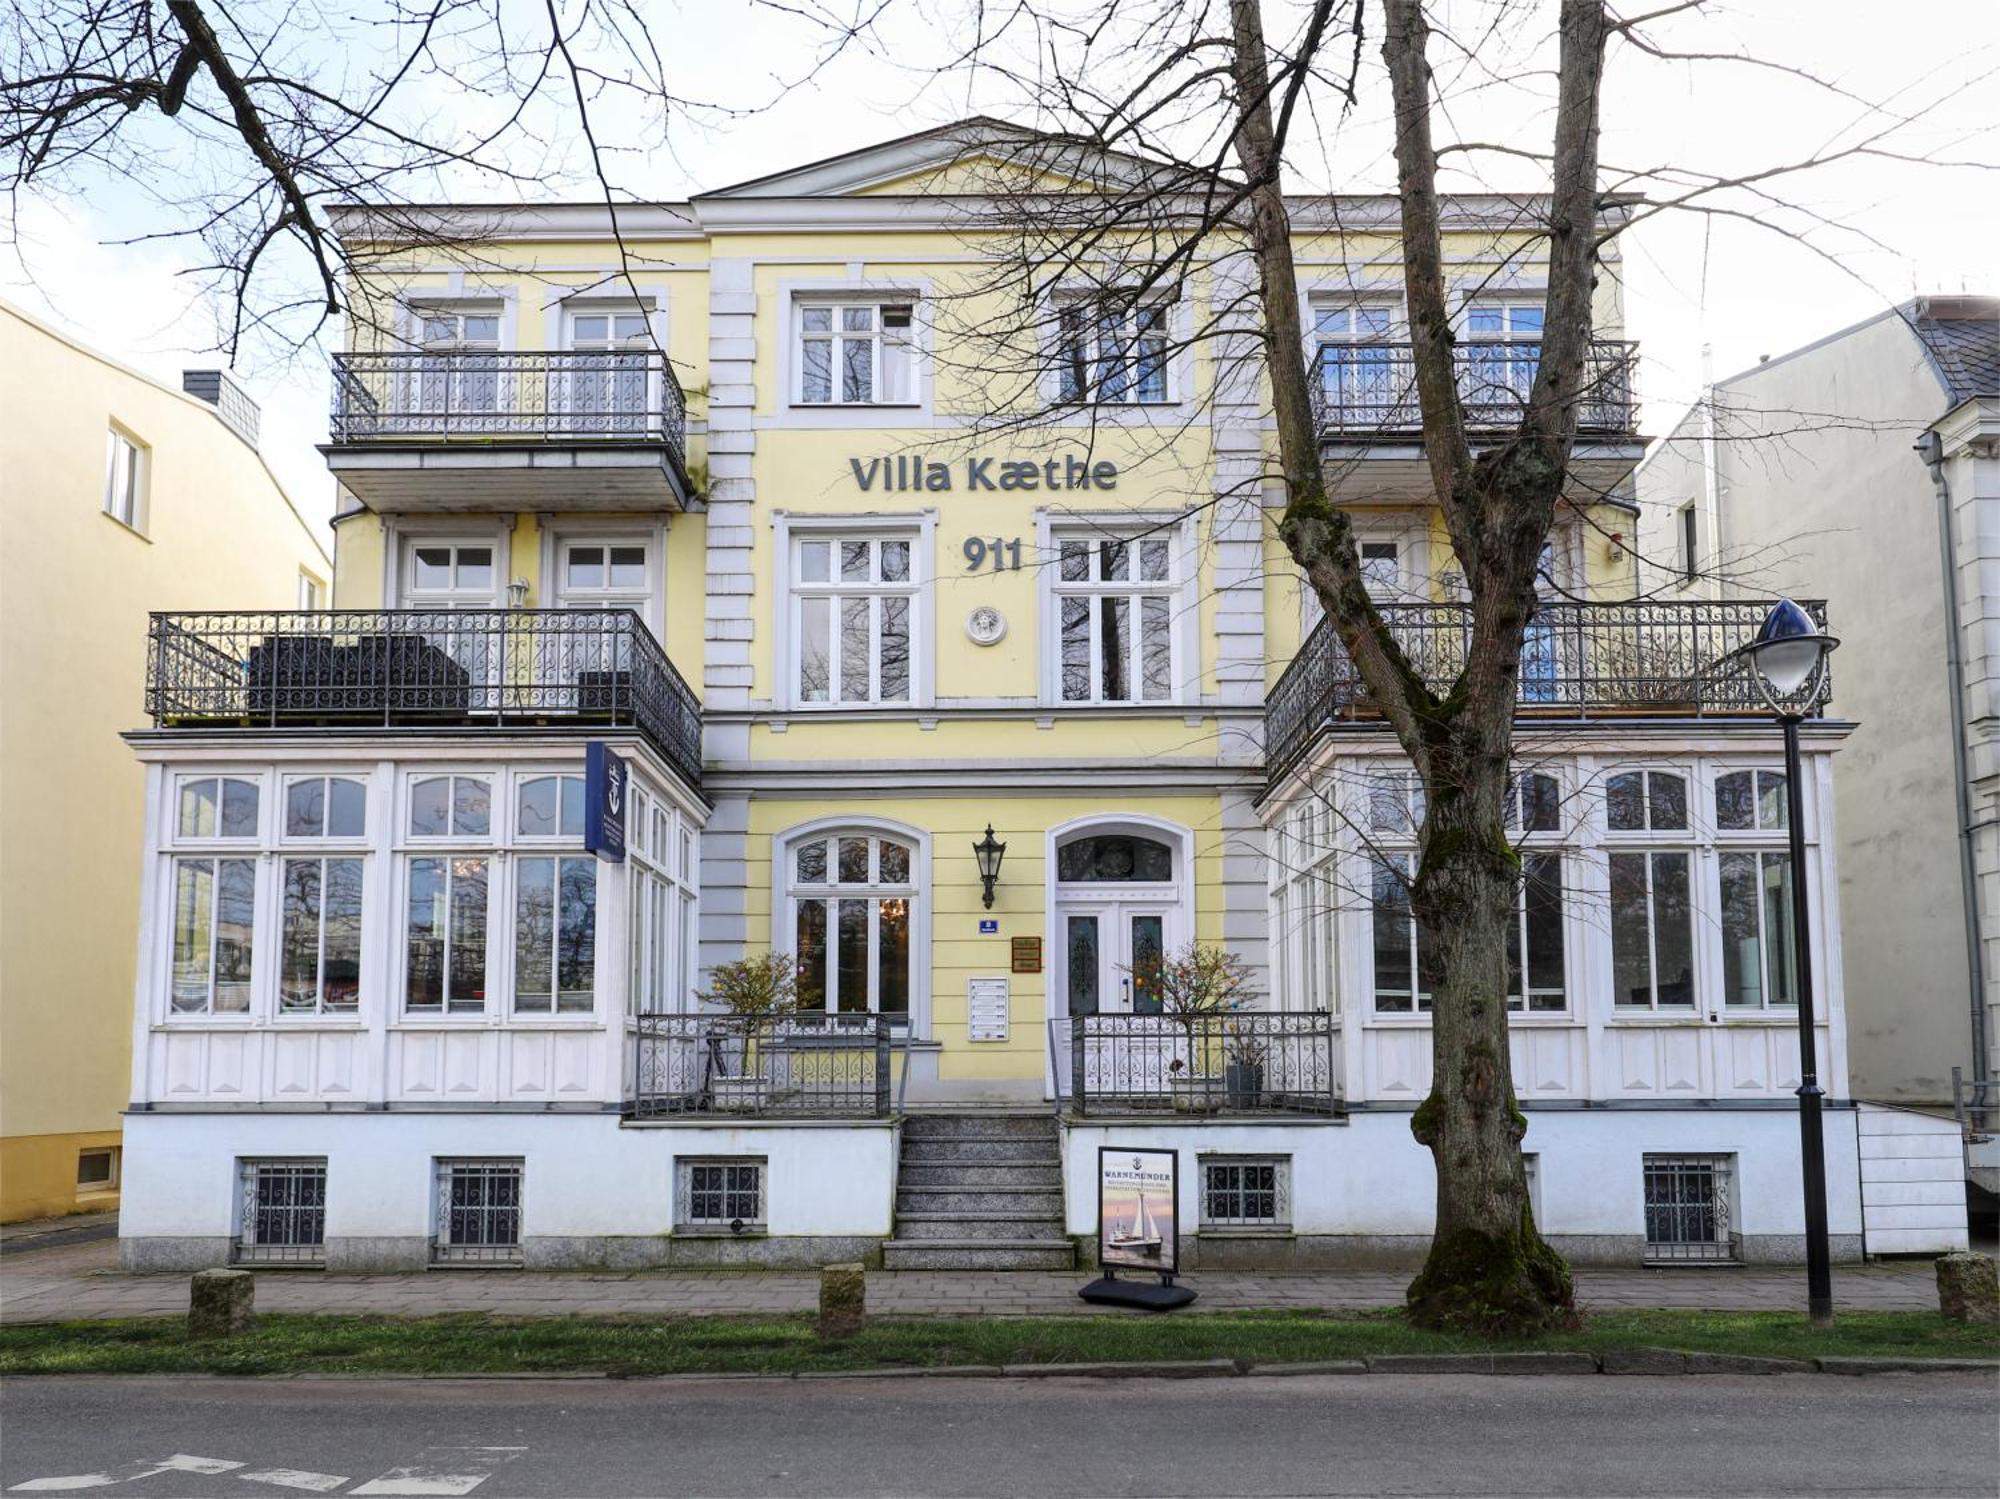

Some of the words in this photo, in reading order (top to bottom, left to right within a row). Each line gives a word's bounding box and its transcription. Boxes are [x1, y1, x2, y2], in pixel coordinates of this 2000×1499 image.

[849, 455, 951, 492] Villa
[967, 454, 1118, 492] Kæthe
[963, 536, 1021, 571] 911
